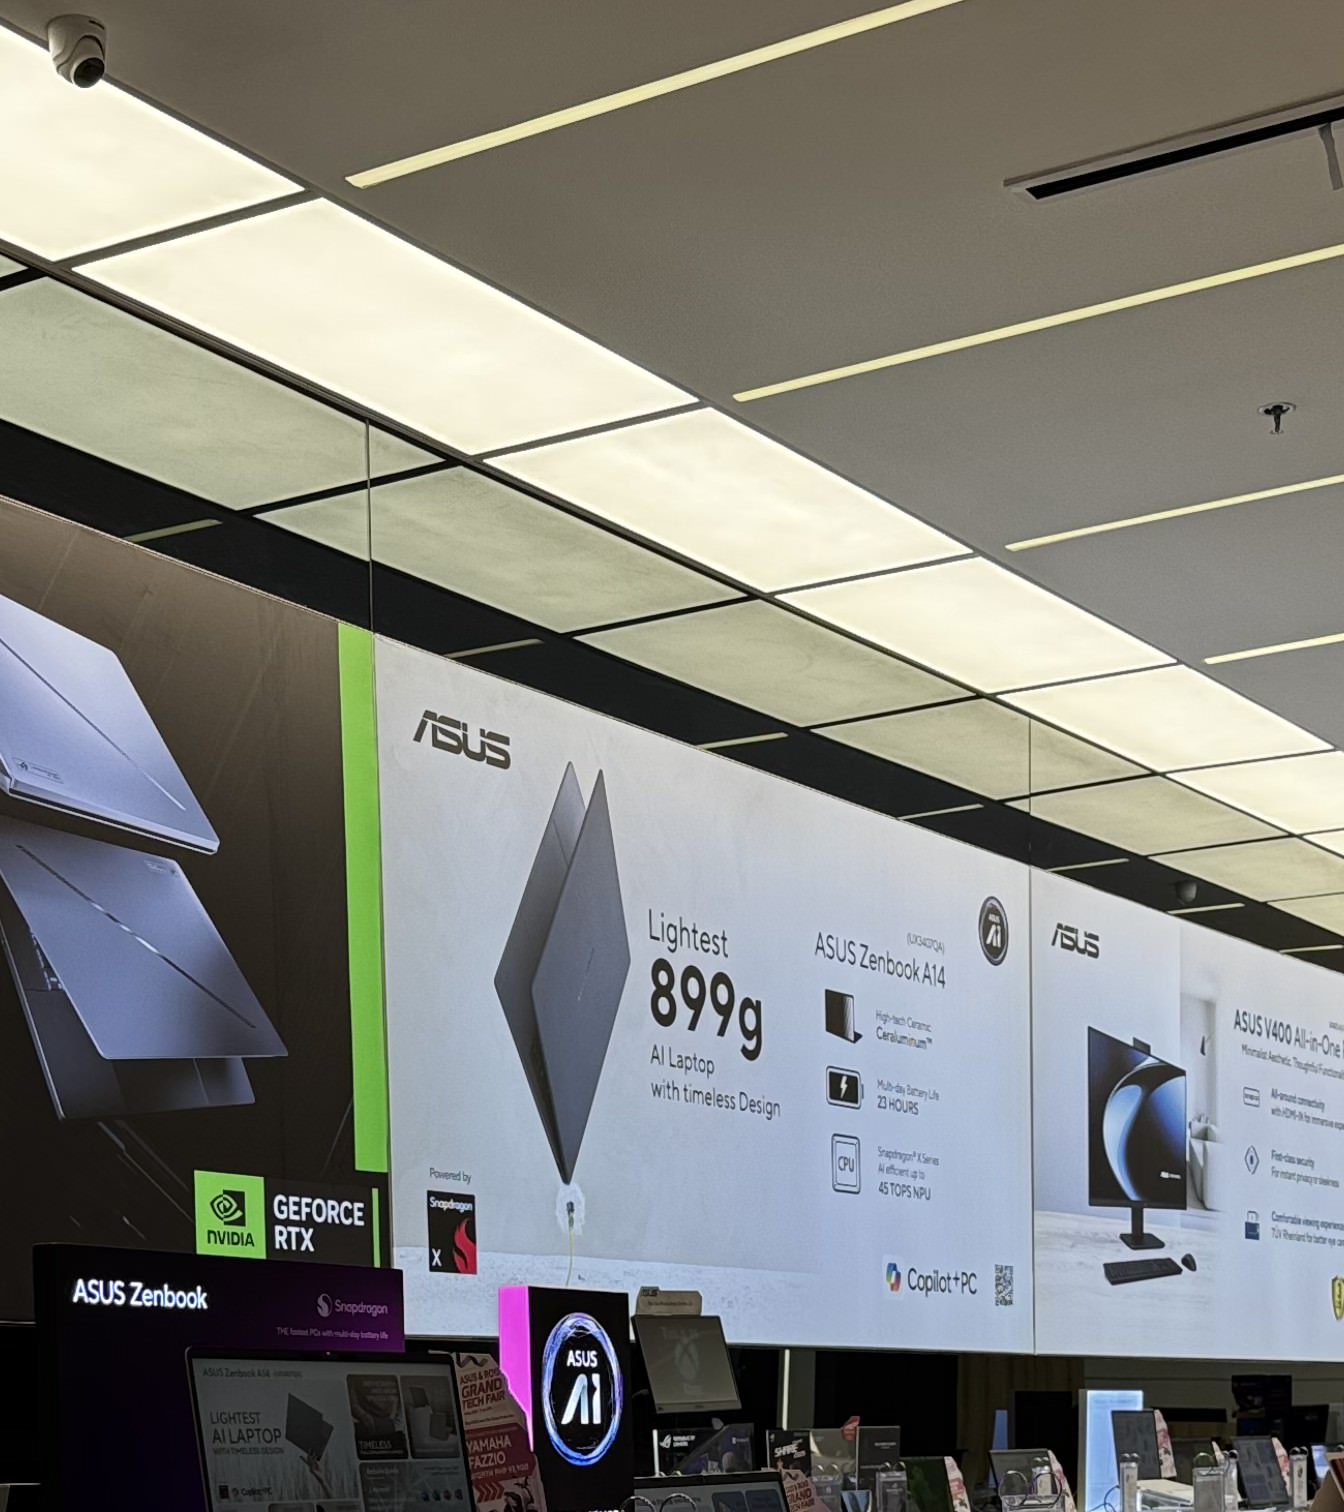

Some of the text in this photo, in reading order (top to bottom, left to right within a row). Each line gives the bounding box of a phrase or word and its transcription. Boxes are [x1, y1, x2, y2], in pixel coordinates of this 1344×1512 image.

[413, 710, 511, 770] ASUS
[649, 908, 728, 958] Lightest
[1051, 923, 1100, 959] ASUS
[815, 932, 946, 989] ASUS Zenbook A14
[650, 958, 762, 1061] 899g
[1234, 1009, 1262, 1037] ASUS
[1264, 1017, 1292, 1045] V400
[650, 1044, 715, 1078] AI Laptop
[651, 1080, 781, 1121] with timeless Design
[878, 1096, 919, 1115] 23 HOURS
[838, 1156, 854, 1172] CPU
[429, 1168, 471, 1185] Powered by
[879, 1182, 931, 1200] 45 TOPS NPU
[273, 1193, 365, 1228] GEFORCE
[429, 1196, 474, 1213] Snapdragon
[273, 1225, 315, 1252] RTX
[431, 1248, 441, 1267] X
[72, 1278, 208, 1310] ASUS Zenbook
[335, 1299, 388, 1317] Snapdragon
[567, 1350, 598, 1367] ASUS
[462, 1378, 502, 1398] GRAND
[561, 1373, 601, 1425] AI
[210, 1411, 261, 1425] LIGHTEST
[212, 1428, 281, 1444] AI LAPTOP
[466, 1434, 512, 1452] YAMAHA
